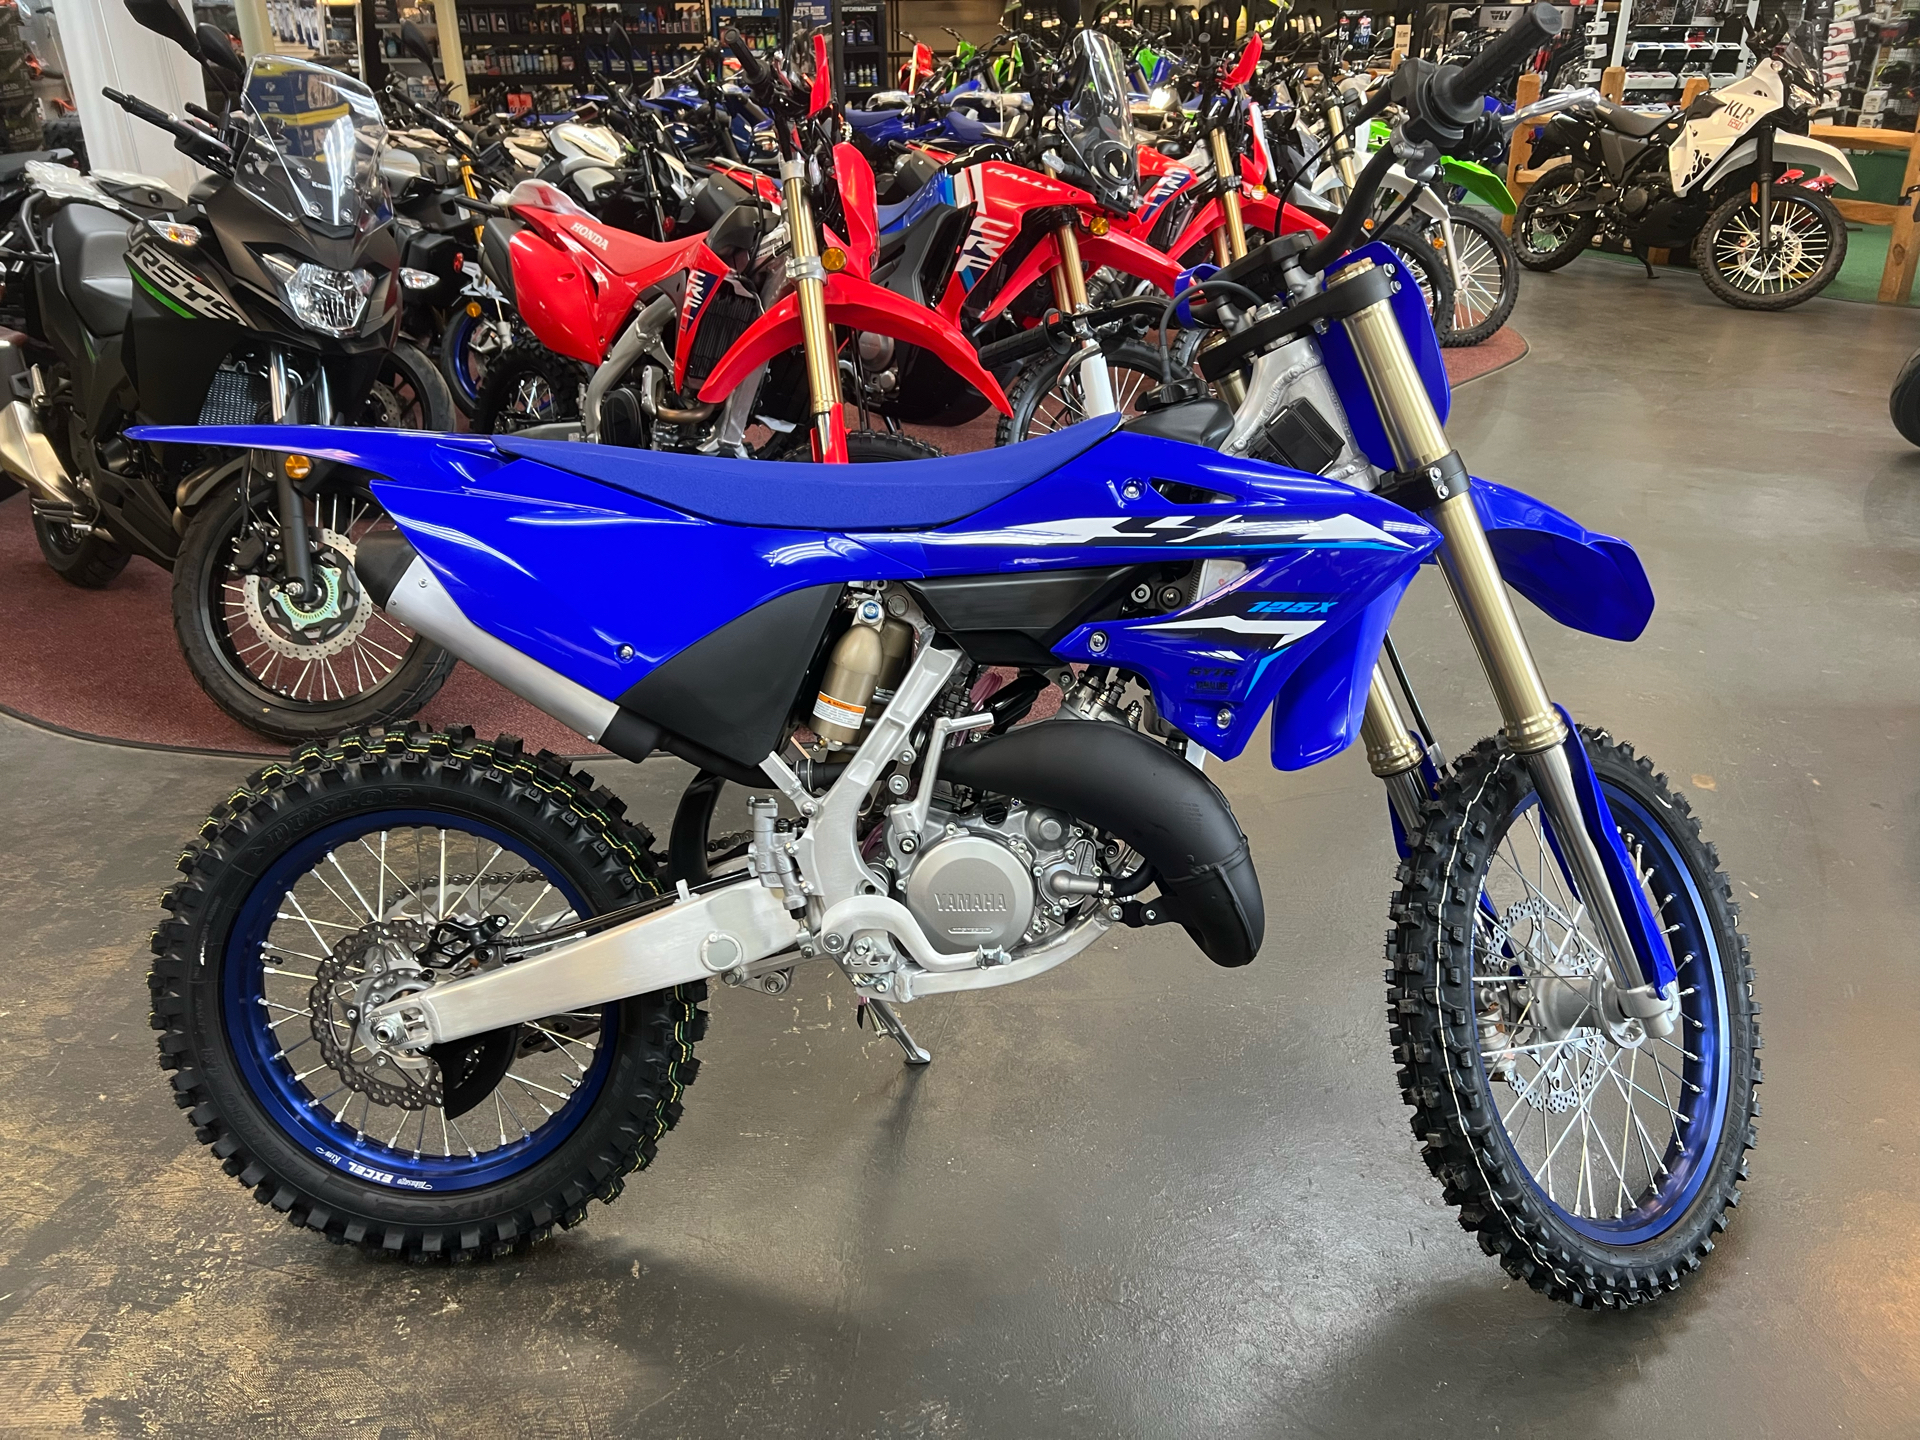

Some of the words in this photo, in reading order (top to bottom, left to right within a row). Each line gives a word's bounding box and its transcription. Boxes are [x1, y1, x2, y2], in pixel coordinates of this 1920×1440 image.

[1723, 99, 1755, 124] KLR
[986, 167, 1062, 192] RALLY
[570, 221, 609, 251] HONDA
[1247, 601, 1339, 614] 125X
[1188, 666, 1238, 677] GYTR
[934, 893, 1007, 912] YAMAHA
[348, 1161, 394, 1184] EXCEL
